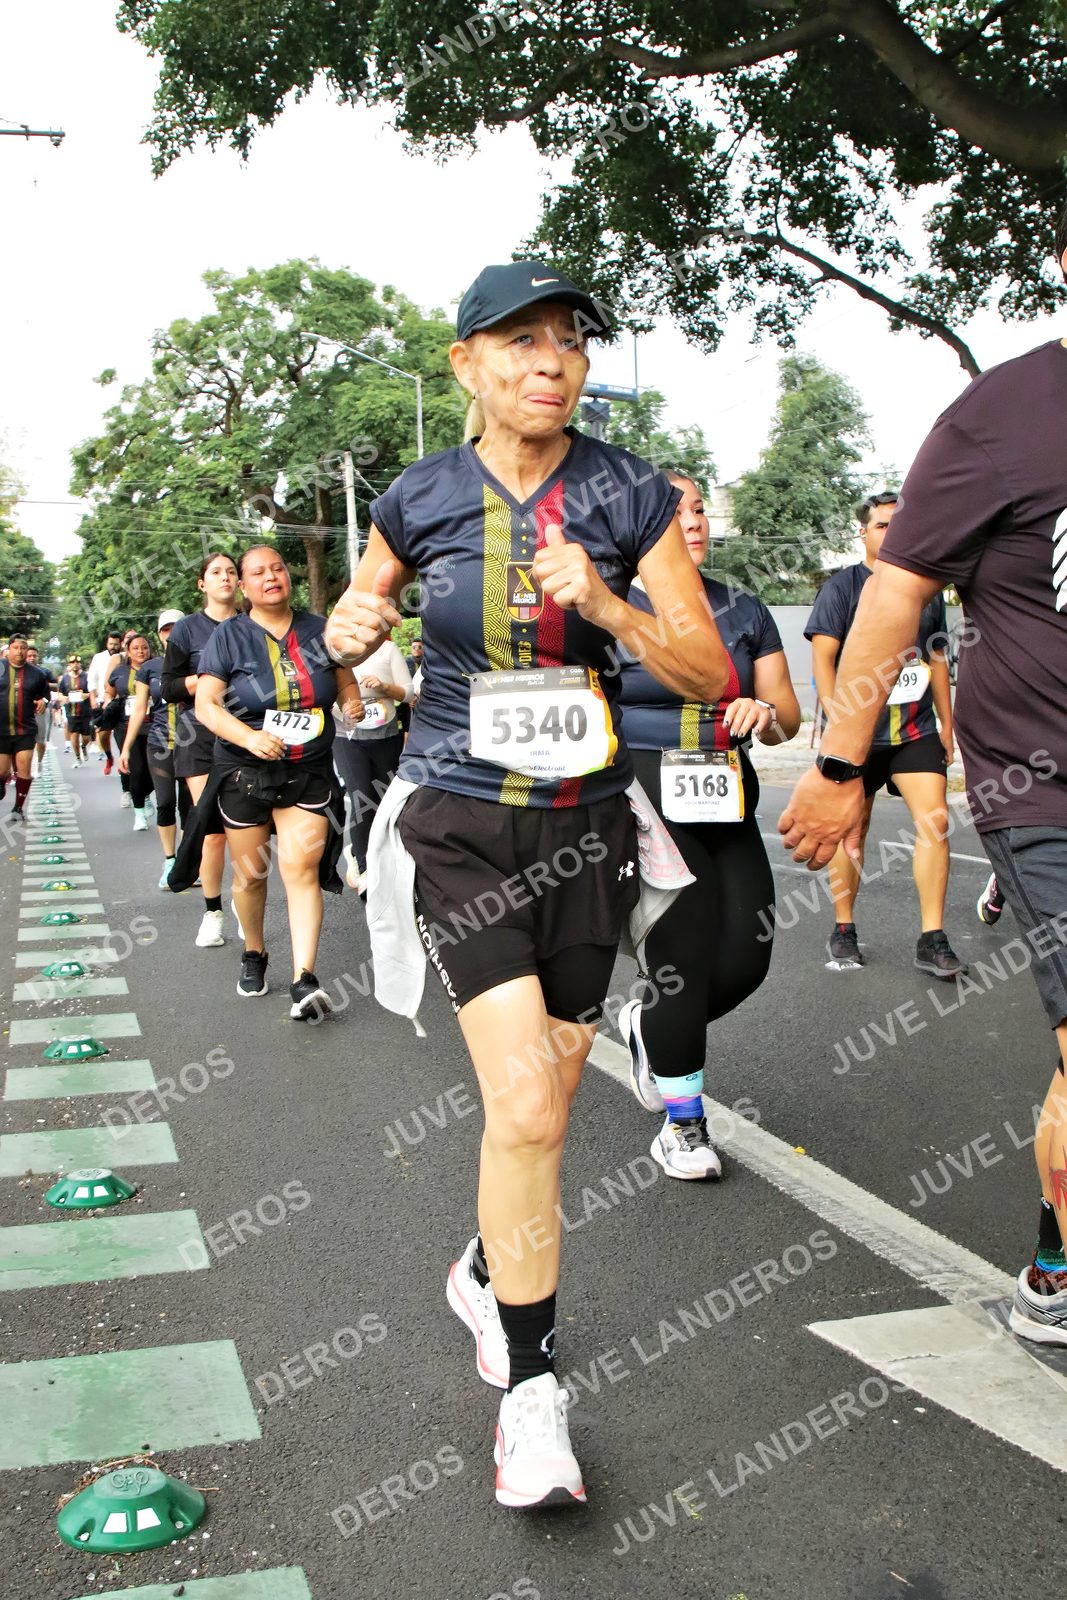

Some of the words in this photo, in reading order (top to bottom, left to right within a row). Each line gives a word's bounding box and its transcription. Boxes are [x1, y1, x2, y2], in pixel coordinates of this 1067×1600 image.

[271, 711, 311, 731] 4772
[491, 704, 588, 745] 5340
[673, 774, 729, 798] 5168
